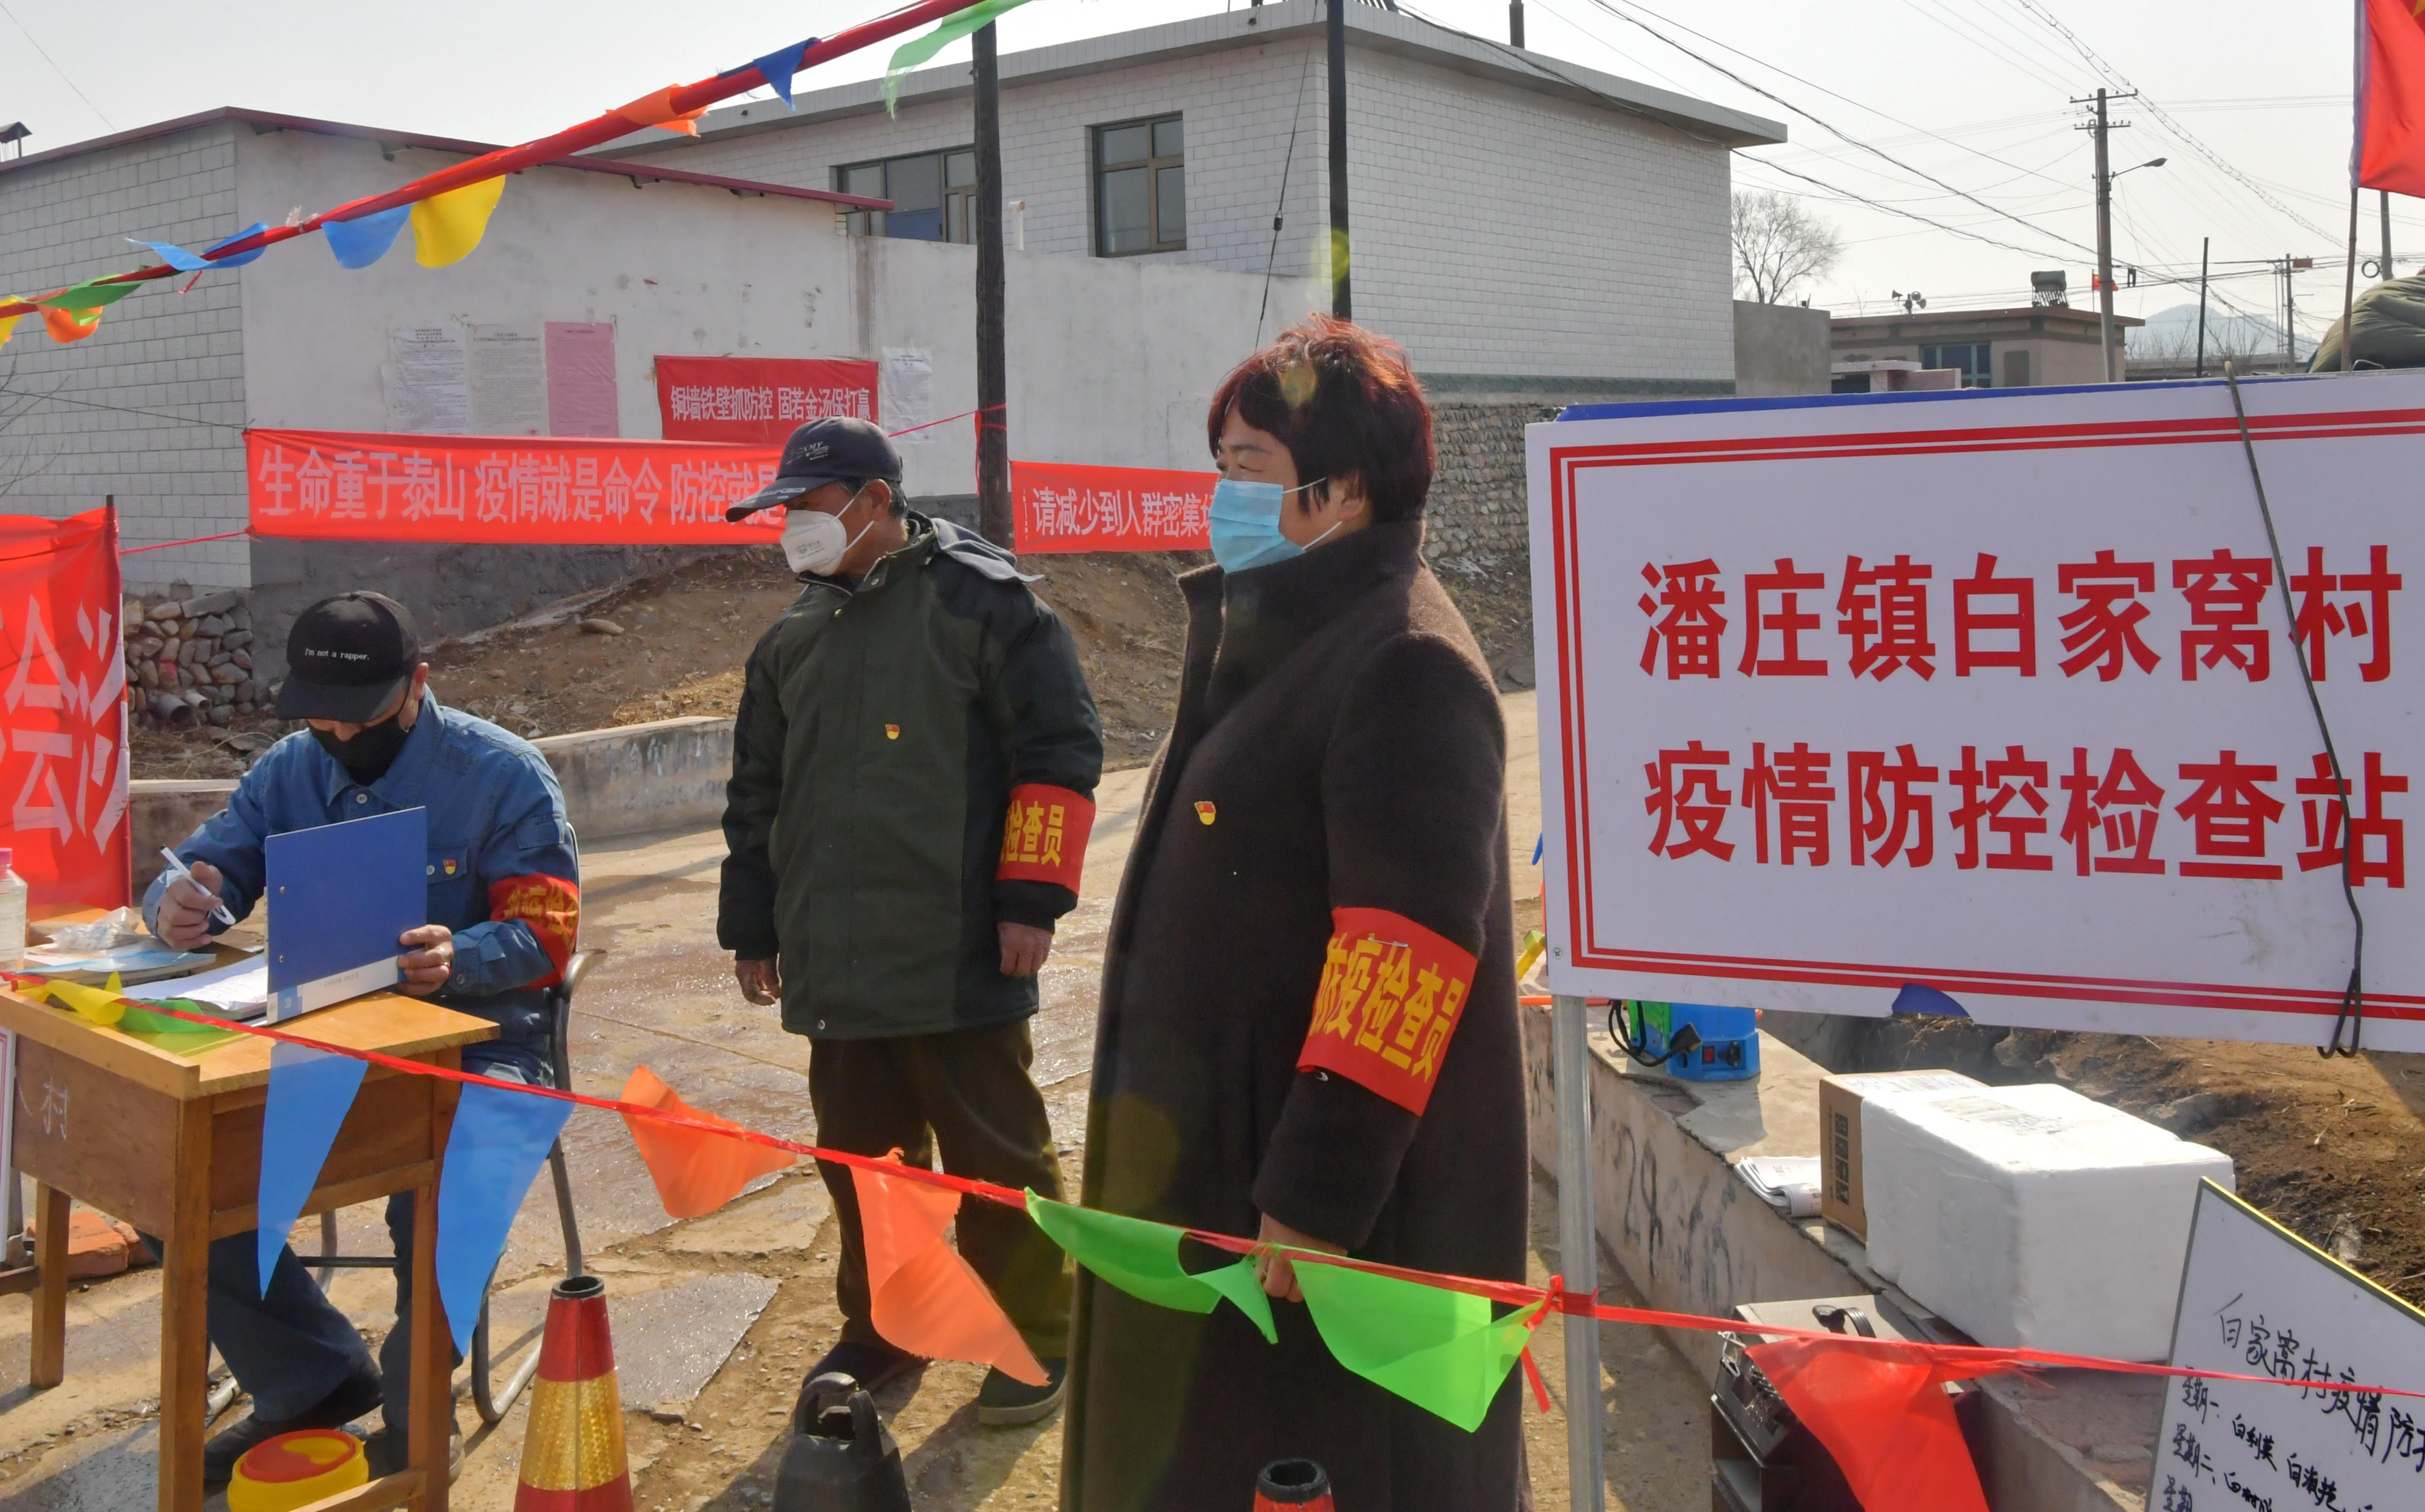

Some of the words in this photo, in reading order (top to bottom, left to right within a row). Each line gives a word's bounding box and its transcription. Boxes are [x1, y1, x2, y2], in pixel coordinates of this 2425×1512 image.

[671, 386, 774, 421] 铜墙铁壁抓防控
[778, 387, 871, 421] 固若金汤保打赢
[258, 444, 466, 522] 生命重于泰山
[474, 451, 663, 525] 疫情就是命令
[670, 459, 787, 527] 防控就是
[1637, 544, 2403, 684] 潘庄镇白家窝村
[340, 653, 369, 661] rapper.
[1000, 800, 1065, 868] 检查员
[1643, 740, 2409, 889] 疫情防控检查站
